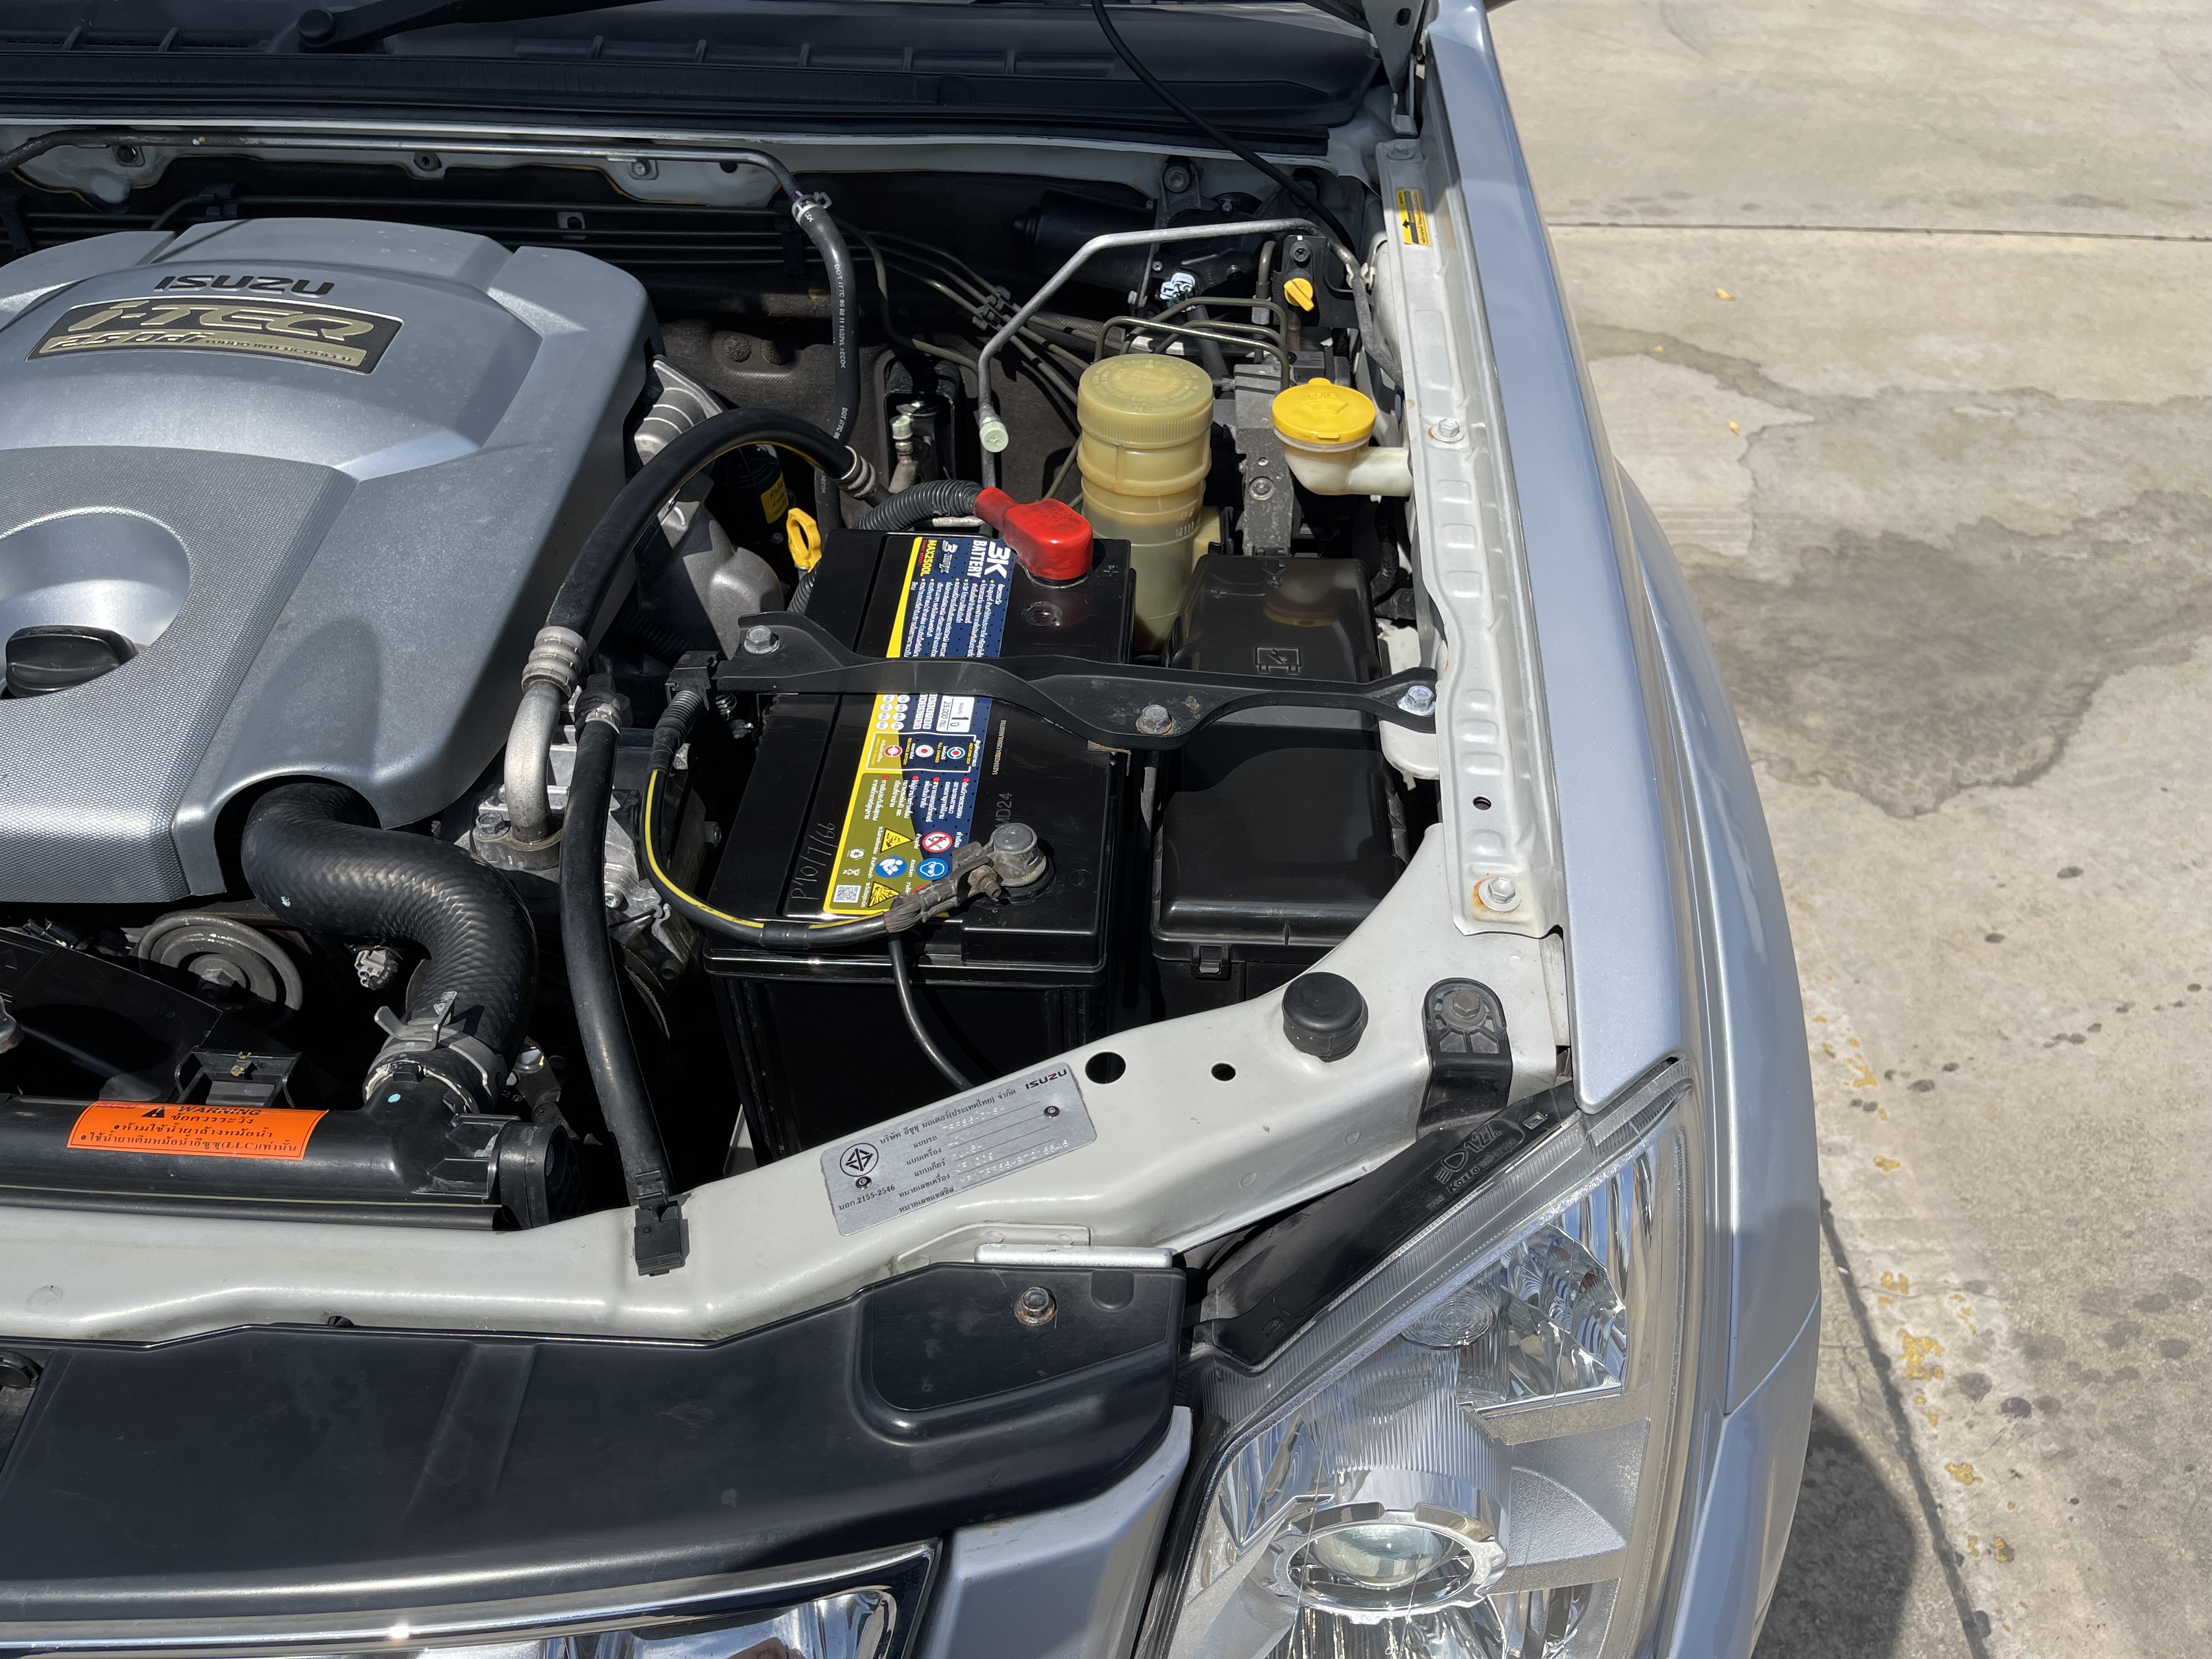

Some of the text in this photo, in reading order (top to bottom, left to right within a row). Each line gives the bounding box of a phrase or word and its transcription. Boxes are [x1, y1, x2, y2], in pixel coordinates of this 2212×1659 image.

[834, 264, 843, 279] DOT
[154, 275, 335, 295] ISUZU
[205, 339, 251, 347] TURBO
[253, 343, 352, 362] INTERCOOLER
[840, 407, 849, 420] DOT
[919, 539, 937, 577] MAX2500L
[966, 539, 988, 578] BATTERY
[984, 541, 1011, 579] 3K
[939, 701, 951, 719] 25,000
[947, 781, 960, 814] สถานะของตาแมว
[955, 782, 968, 818] ต้องมีการตรวจสอบ
[1025, 1069, 1068, 1090] ISUZU
[171, 1112, 253, 1124] ข้อควรระวัง
[179, 1106, 262, 1116] WARNING
[880, 1131, 901, 1144] บริษัท
[922, 1096, 995, 1128] มอเตอร์(ประเทศไทย)
[997, 1088, 1017, 1100] จำกัด
[122, 1122, 273, 1138] ห้ามใช้น้ำยาล้างหม้อน้ำ
[913, 1135, 938, 1149] แบบรถ
[906, 1147, 942, 1166] แบบเครื่อง
[914, 1160, 946, 1177] แบบเกียร์
[899, 1172, 950, 1198] หมายเลขเครื่อง
[838, 1185, 895, 1211] มอก.2155-2546
